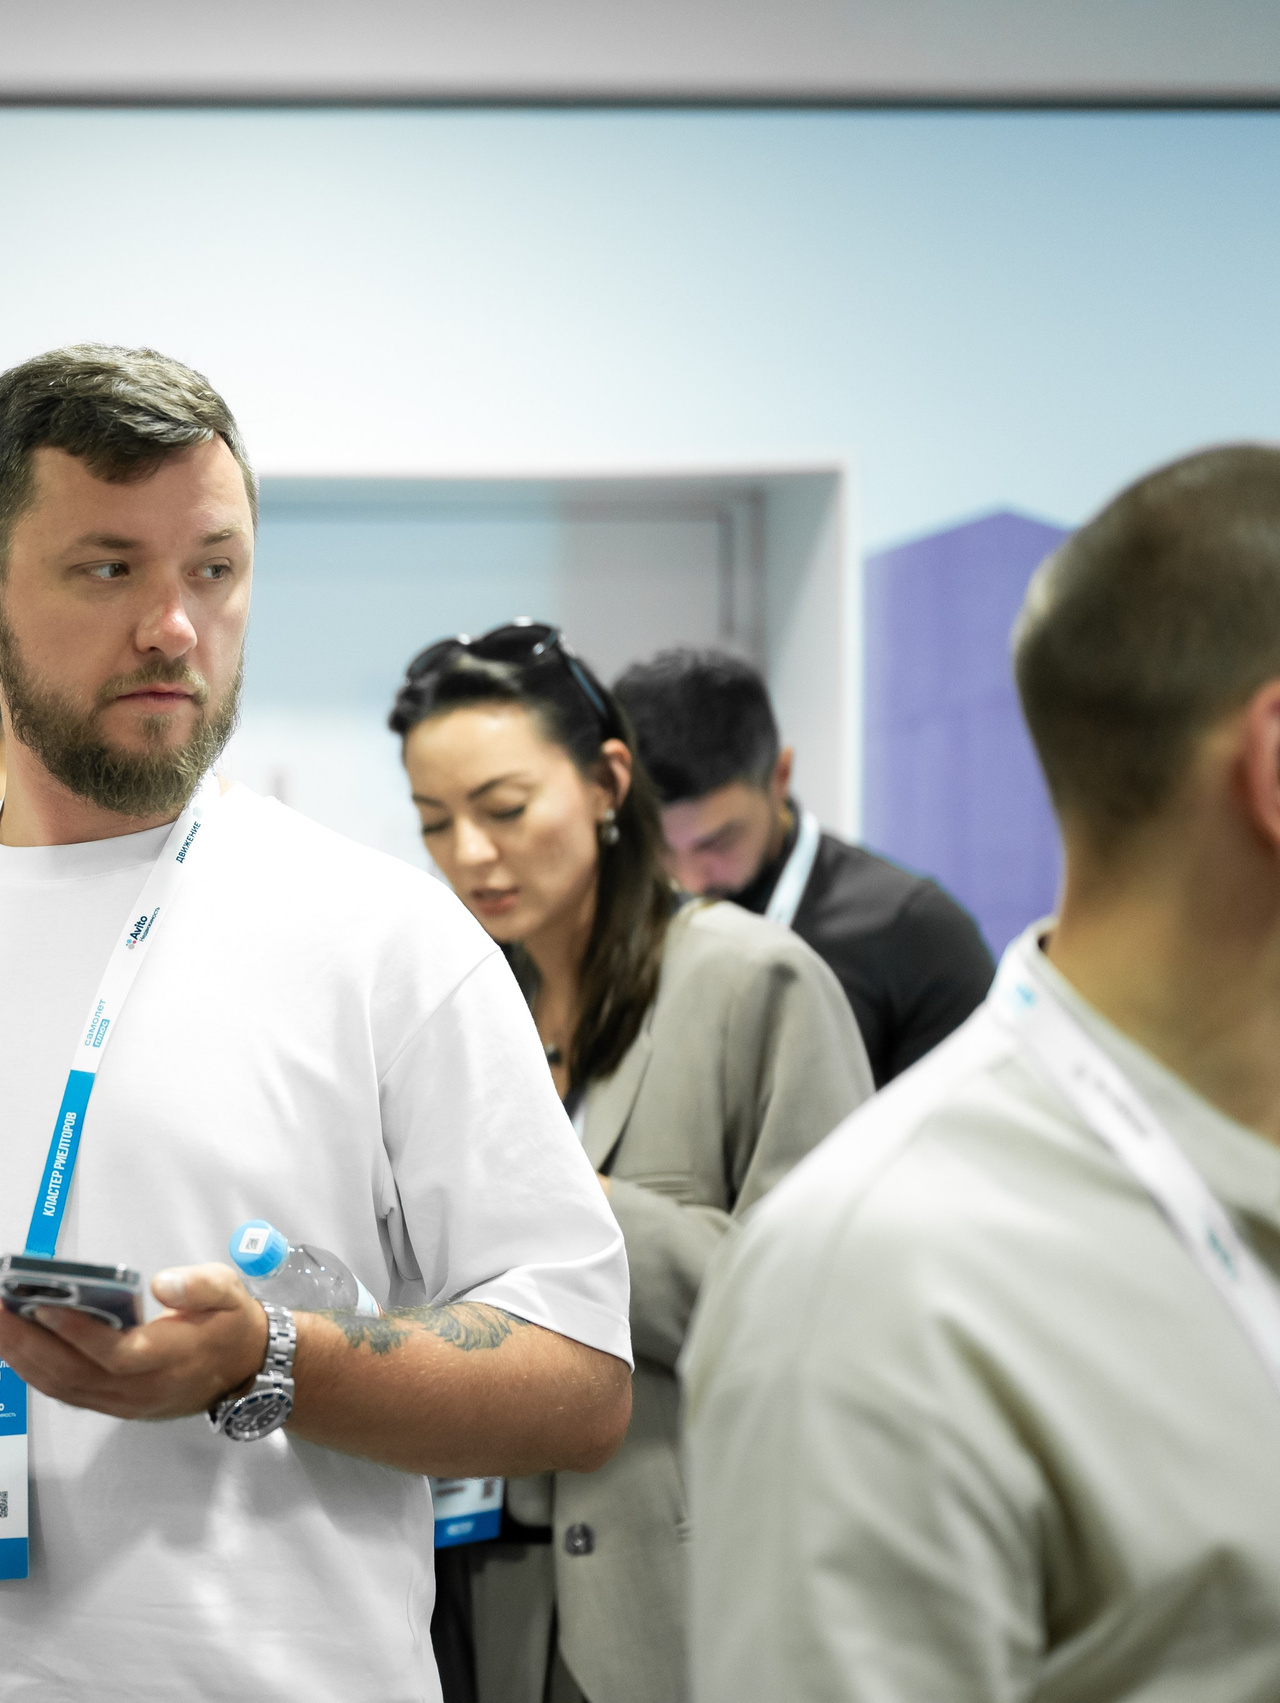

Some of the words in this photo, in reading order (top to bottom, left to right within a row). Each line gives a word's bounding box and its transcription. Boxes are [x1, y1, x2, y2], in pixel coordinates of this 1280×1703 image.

[175, 821, 202, 864] ДВИЖЕНИЕ
[129, 915, 148, 940] Avito
[84, 998, 107, 1047] самолет
[42, 1170, 63, 1217] КЛАСТЕР
[53, 1111, 77, 1170] РИЕЛТОРОВ
